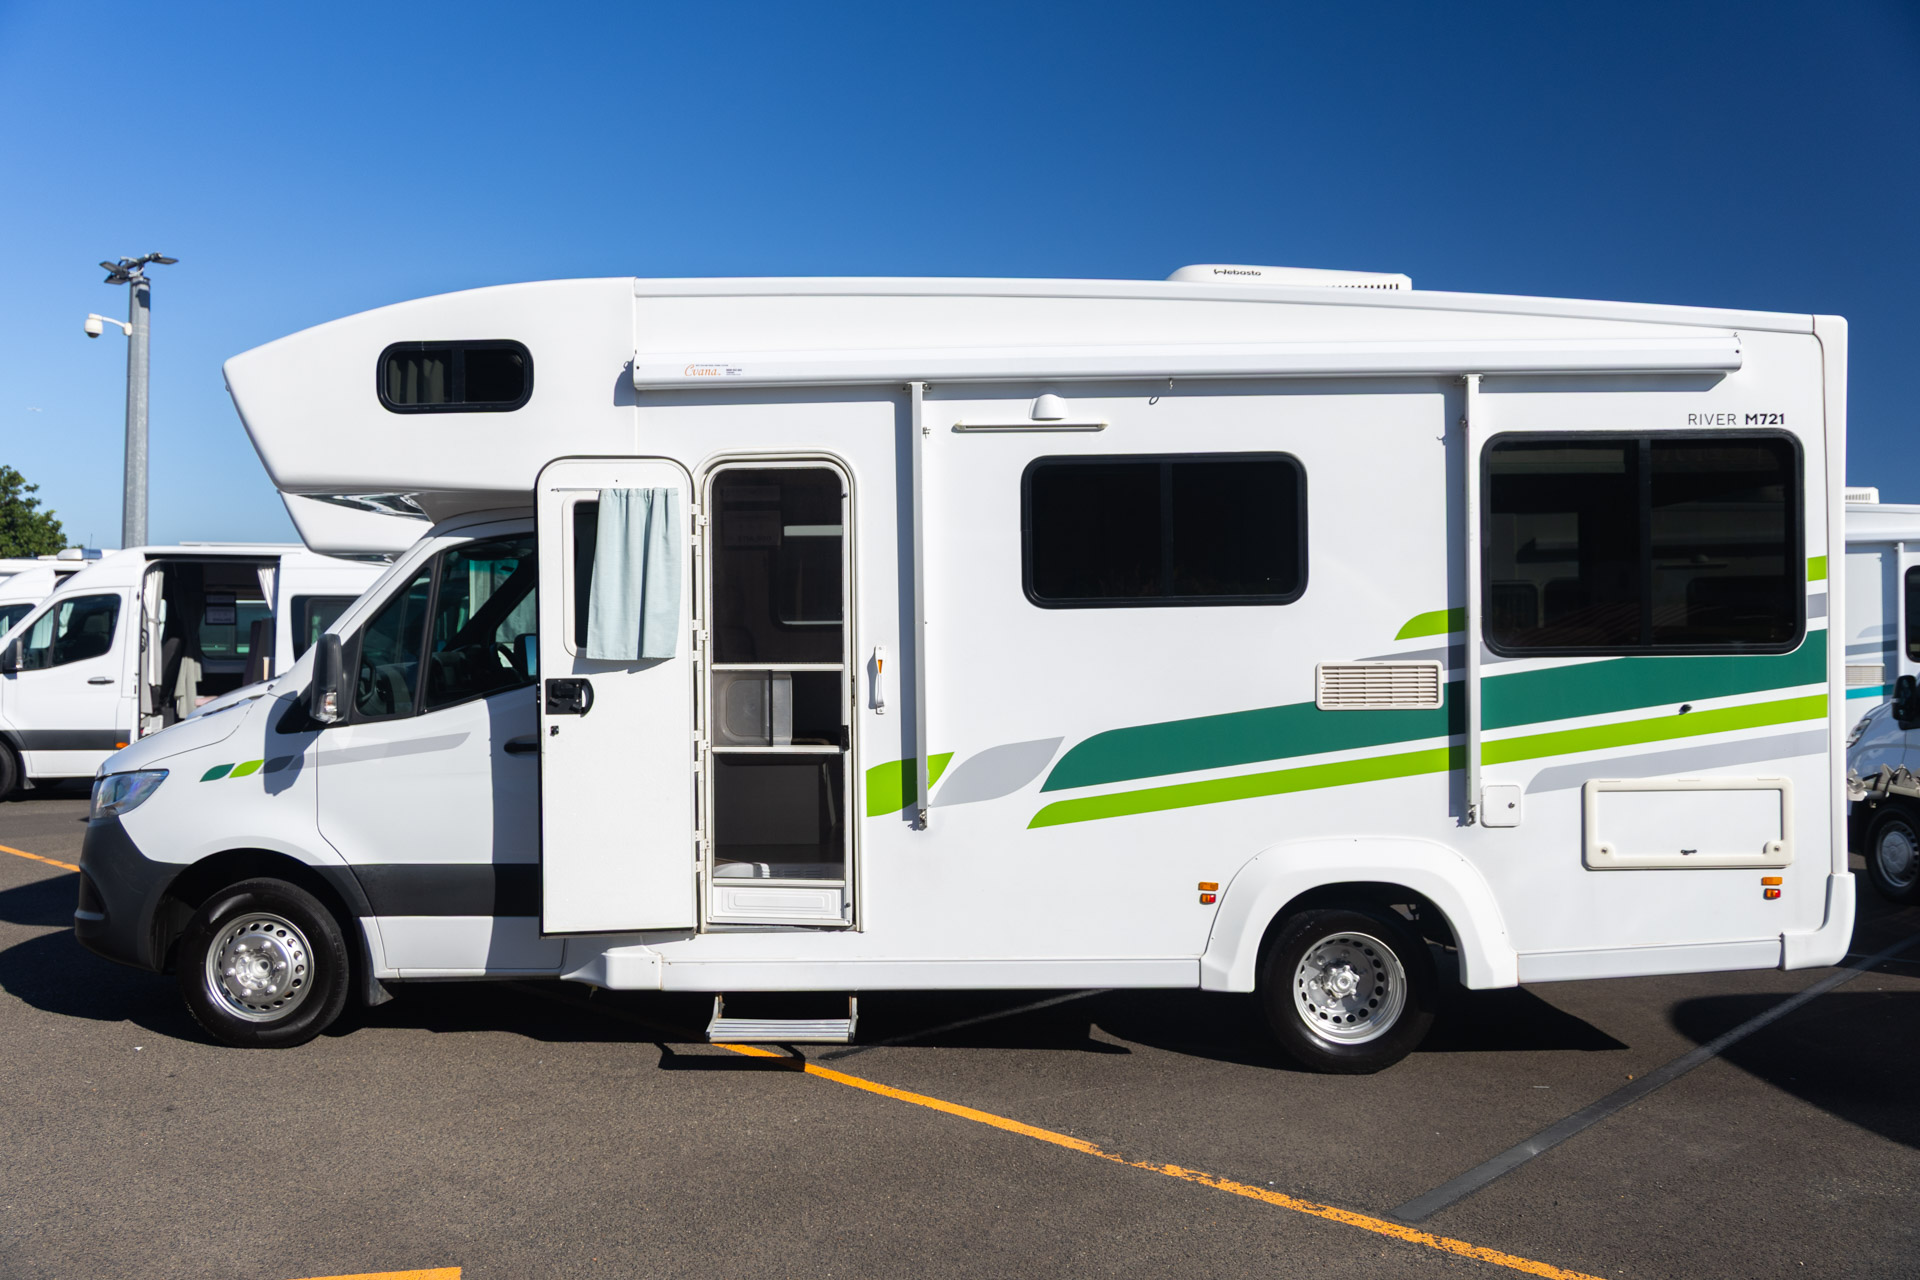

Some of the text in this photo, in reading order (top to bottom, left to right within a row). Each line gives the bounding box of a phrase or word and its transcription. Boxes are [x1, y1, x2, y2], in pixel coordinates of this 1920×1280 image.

[1213, 268, 1262, 276] Webasto
[1688, 413, 1785, 425] RIVER M721
